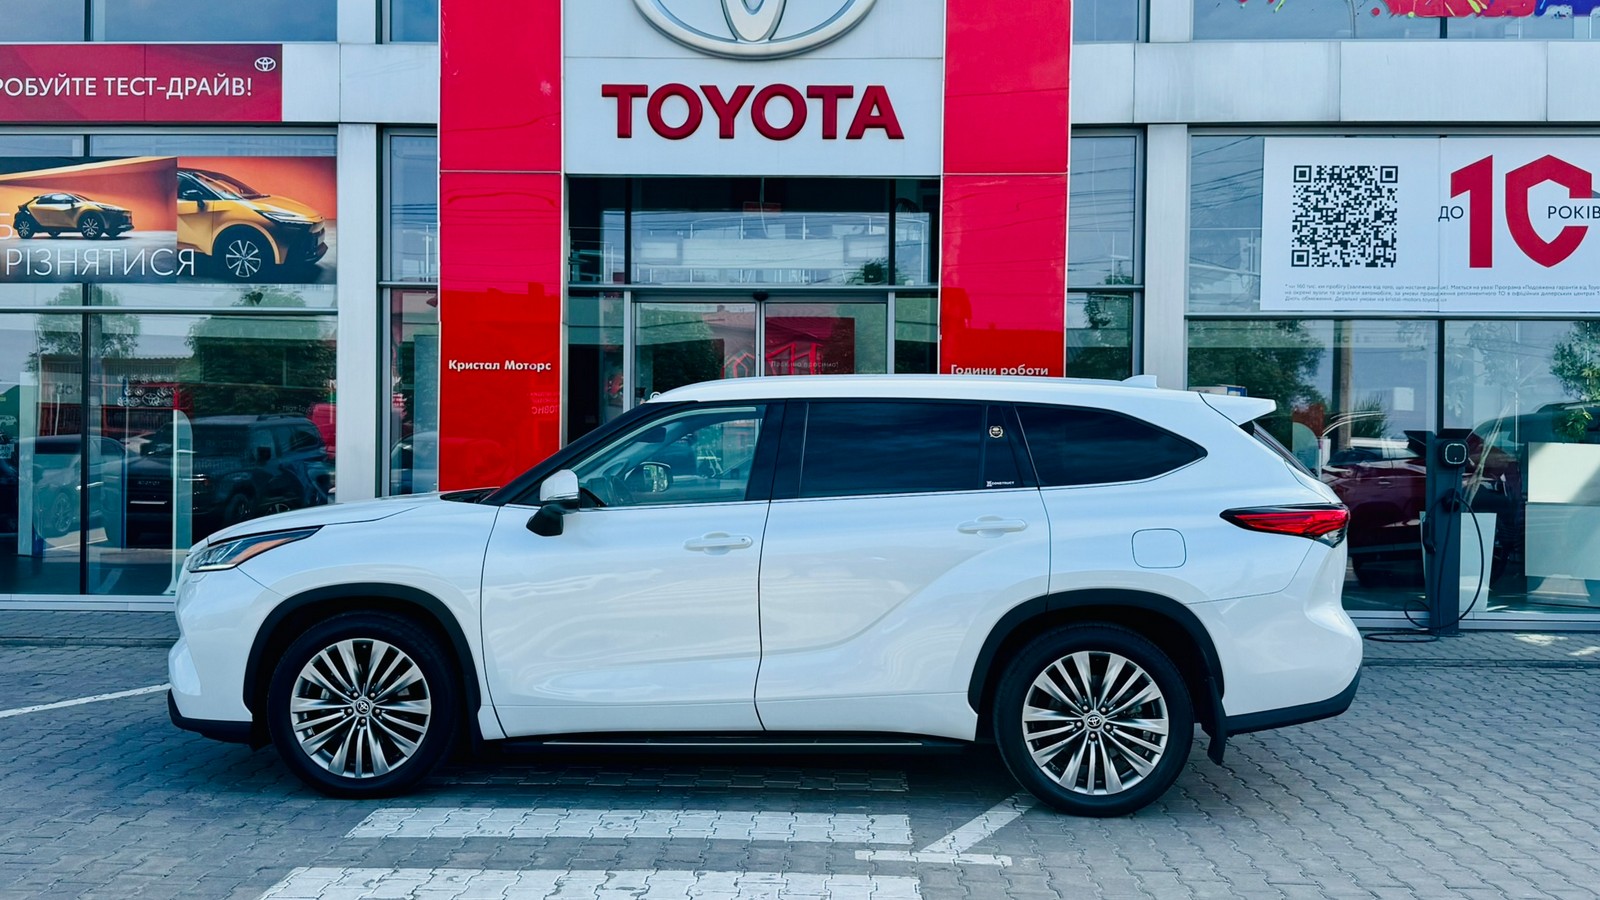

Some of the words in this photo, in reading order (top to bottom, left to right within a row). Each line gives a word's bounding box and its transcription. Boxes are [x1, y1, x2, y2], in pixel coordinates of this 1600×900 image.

[103, 73, 252, 100] ТЕСТ-ДРАЙВ!
[601, 83, 905, 140] TOYOTA
[1438, 206, 1464, 222] ДО
[1547, 206, 1600, 219] РОКІВ
[6, 248, 196, 277] РІЗНЯТИСЯ
[448, 360, 500, 372] Кристал
[504, 360, 552, 372] Моторс
[950, 363, 997, 375] Години
[1000, 363, 1049, 376] роботи
